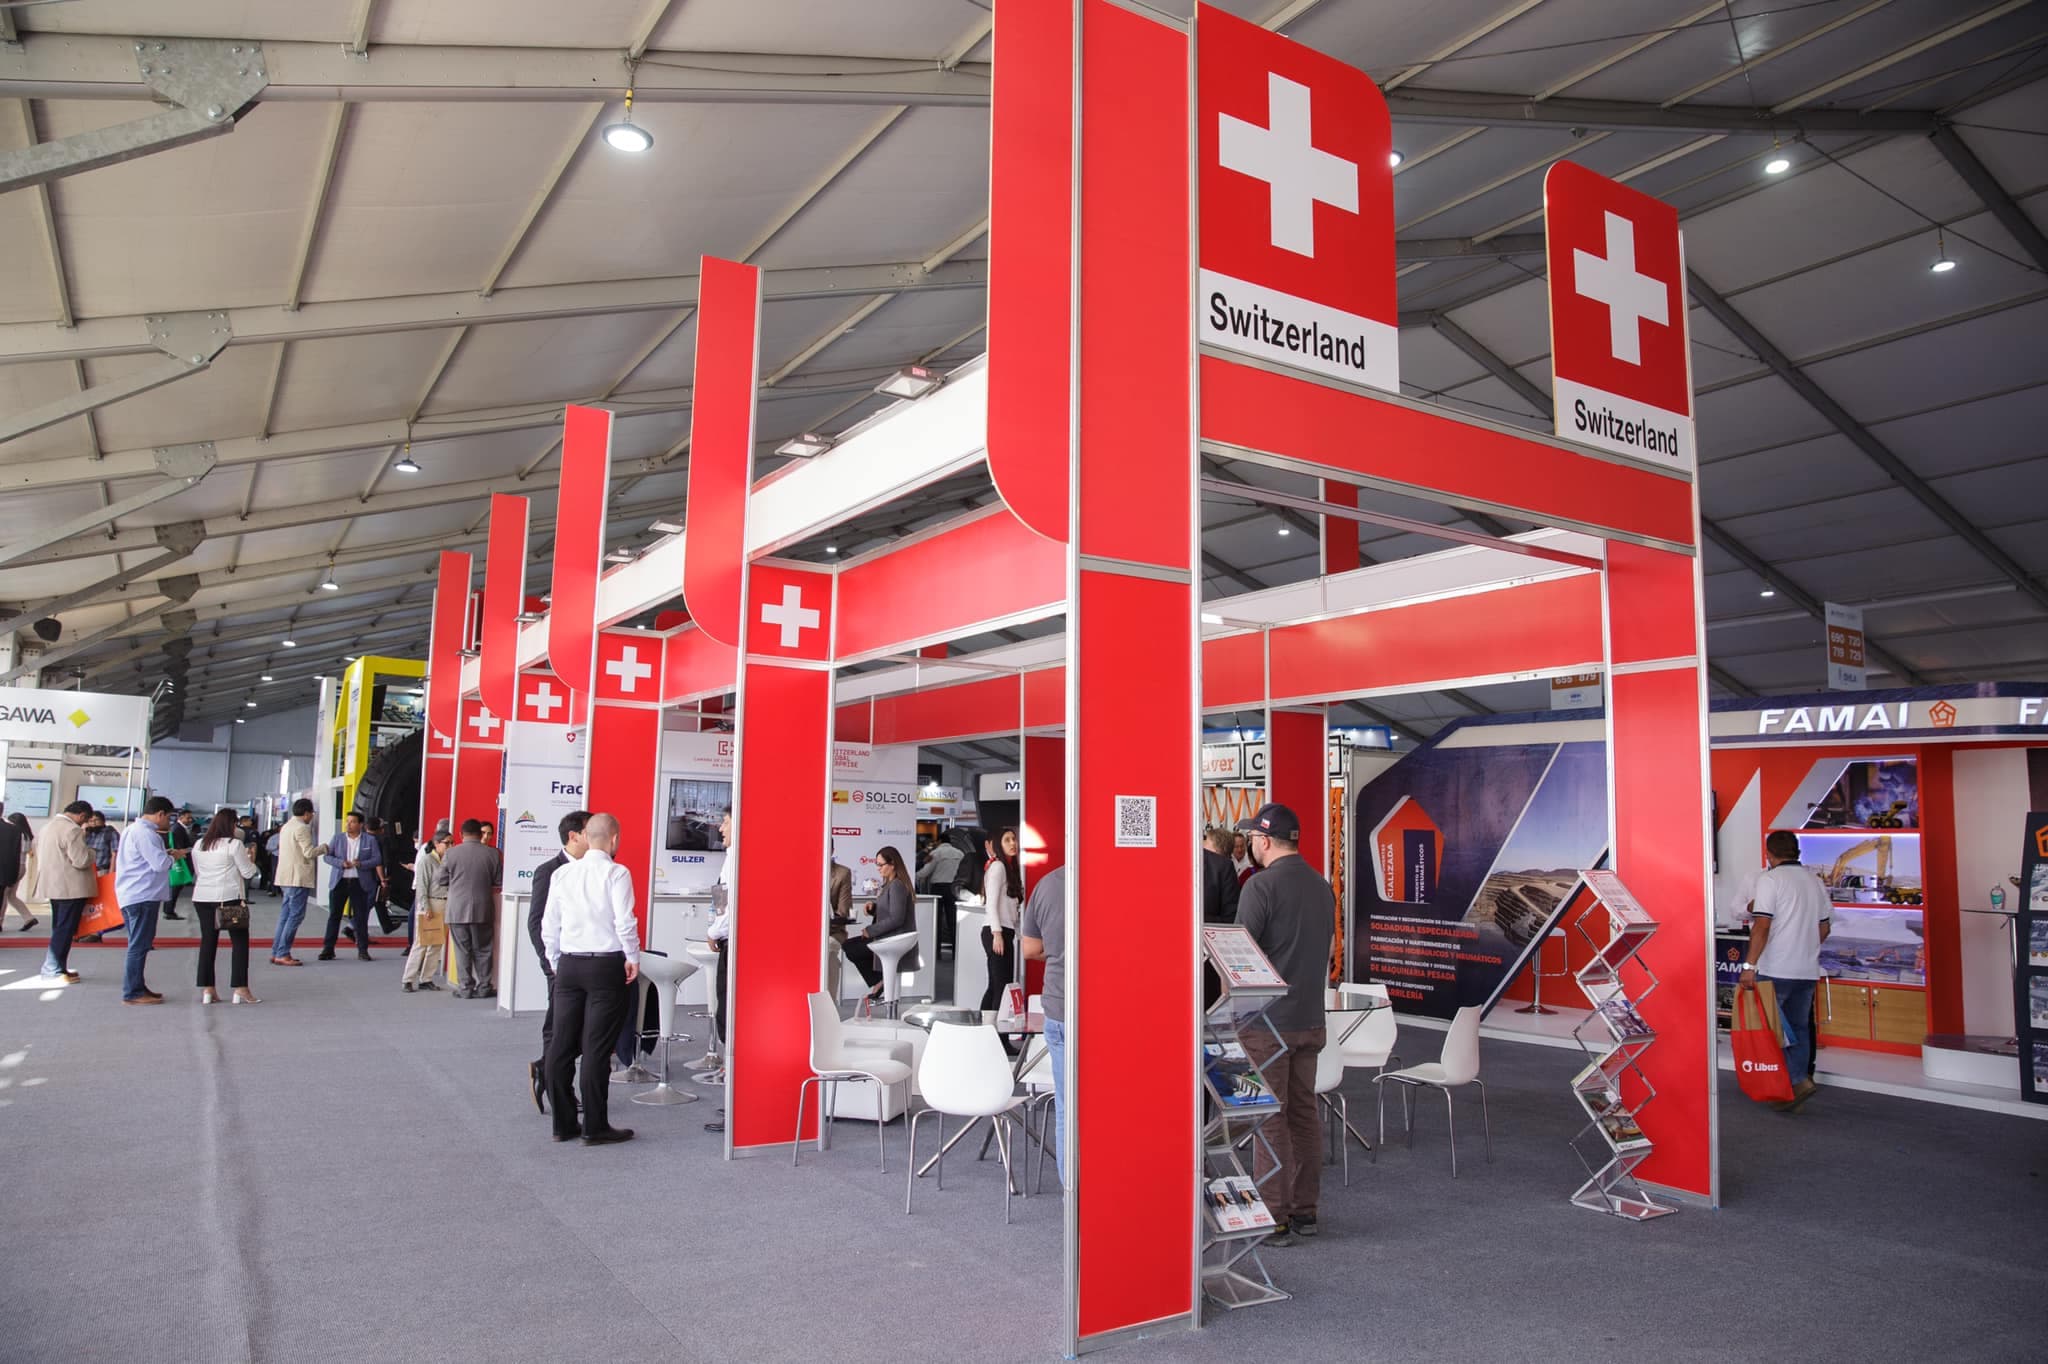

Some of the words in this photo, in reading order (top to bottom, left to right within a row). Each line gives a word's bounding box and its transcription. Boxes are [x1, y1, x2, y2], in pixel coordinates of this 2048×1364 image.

[1209, 291, 1366, 370] Switzerland
[1574, 398, 1679, 457] Switzerland
[1758, 702, 1909, 734] FAMAI
[1252, 752, 1265, 770] C
[551, 781, 583, 795] Frac
[672, 855, 705, 864] SULZER
[1370, 922, 1416, 933] SOLDADURA
[1416, 925, 1478, 939] ESPECIALIZADA
[1370, 935, 1404, 945] FABRICACIÓN
[1409, 938, 1452, 949] MANTENIMIENTO
[1370, 944, 1404, 953] CILINDROS
[1405, 946, 1449, 958] HIDRÁULICOS
[1456, 952, 1502, 964] NEUMÁTICOS
[1370, 963, 1379, 972] DE
[1381, 964, 1425, 977] MAQUINARIA
[1427, 969, 1456, 980] PESADA
[1388, 987, 1424, 1000] RRILERÍA
[1754, 1063, 1779, 1071] Libus
